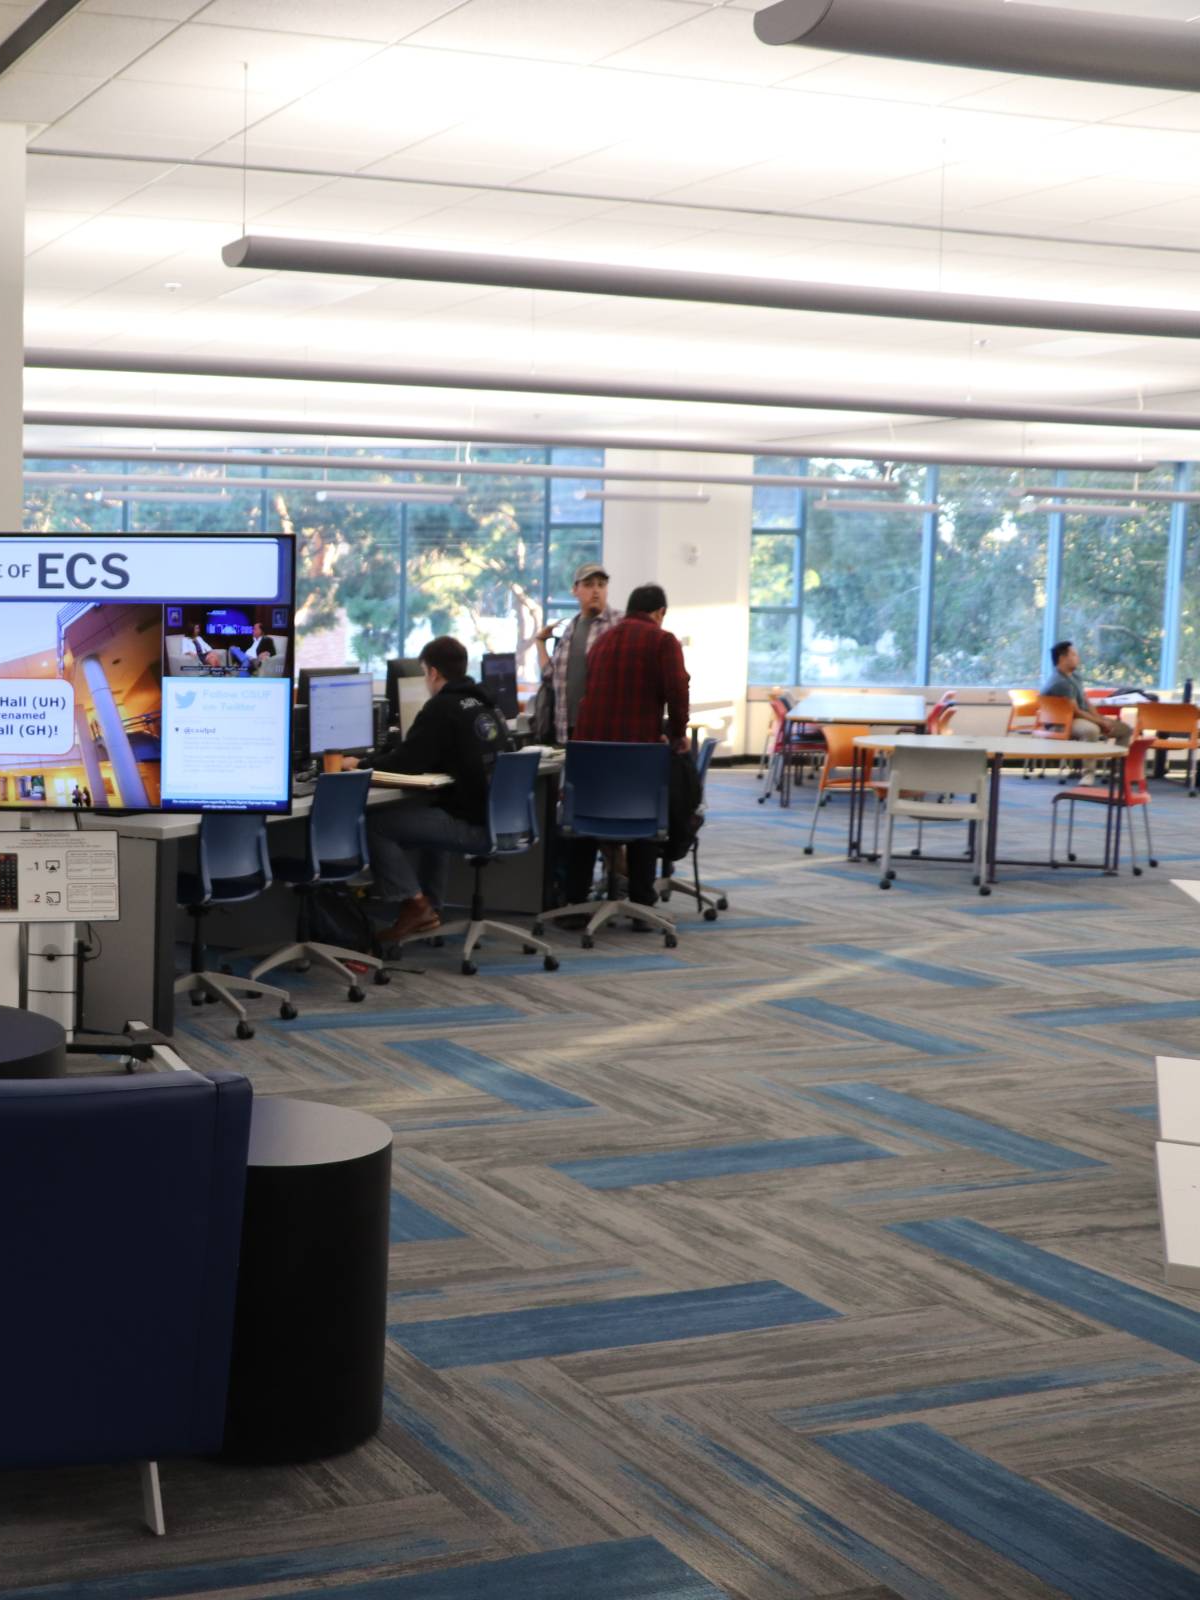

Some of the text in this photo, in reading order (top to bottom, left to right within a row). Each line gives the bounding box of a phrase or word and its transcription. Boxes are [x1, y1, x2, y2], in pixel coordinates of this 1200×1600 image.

[7, 563, 32, 578] OF
[37, 552, 130, 590] ECS
[0, 696, 27, 708] Hall
[32, 696, 66, 710] (UH)
[19, 724, 59, 738] (GH)!
[34, 862, 39, 871] 1
[34, 894, 41, 904] 2
